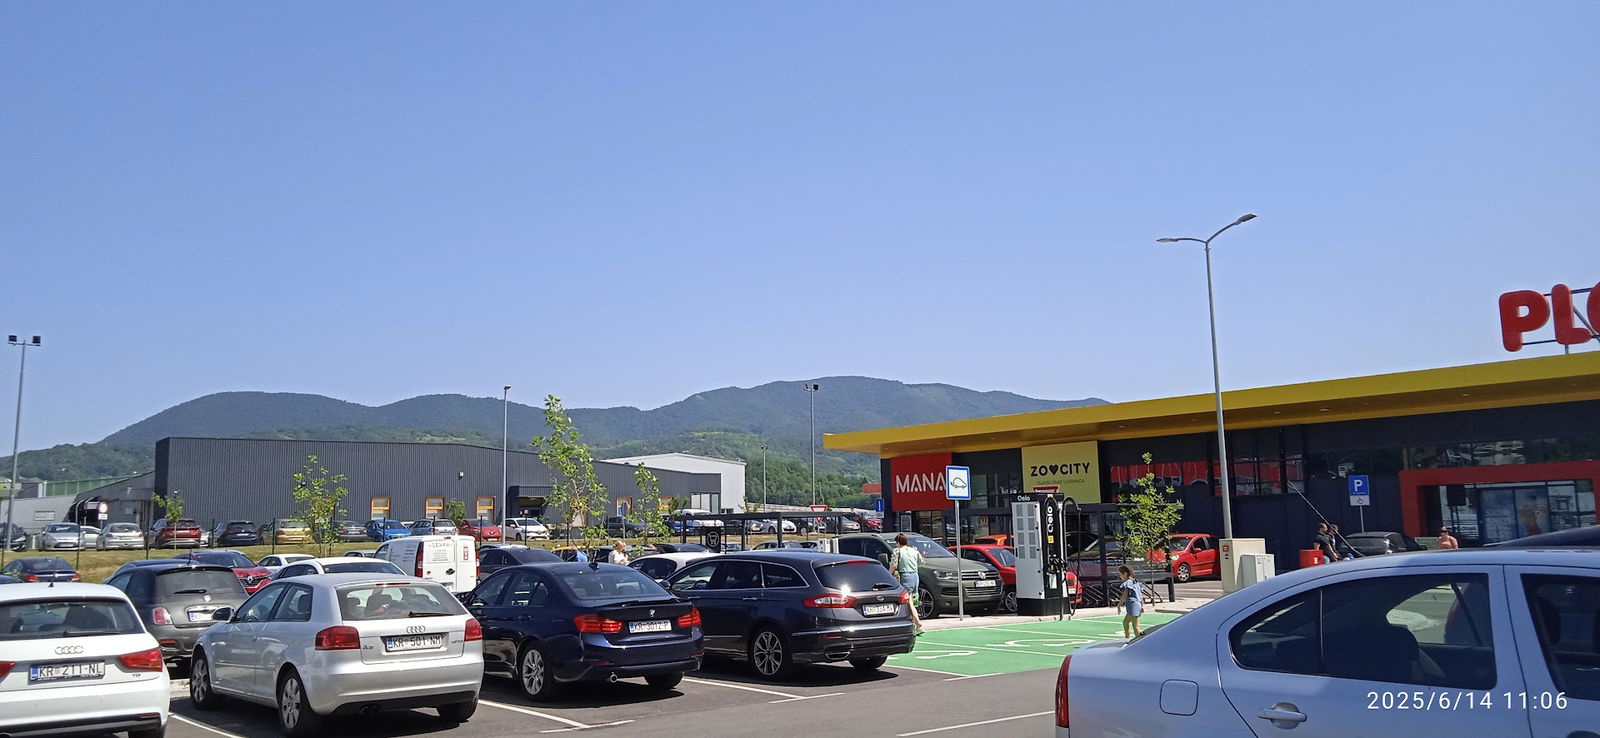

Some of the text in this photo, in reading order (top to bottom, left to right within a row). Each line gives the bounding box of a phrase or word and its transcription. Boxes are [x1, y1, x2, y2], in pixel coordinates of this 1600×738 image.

[895, 472, 946, 493] MANA
[1354, 480, 1363, 491] P
[392, 637, 404, 648] KR
[40, 666, 54, 677] KR
